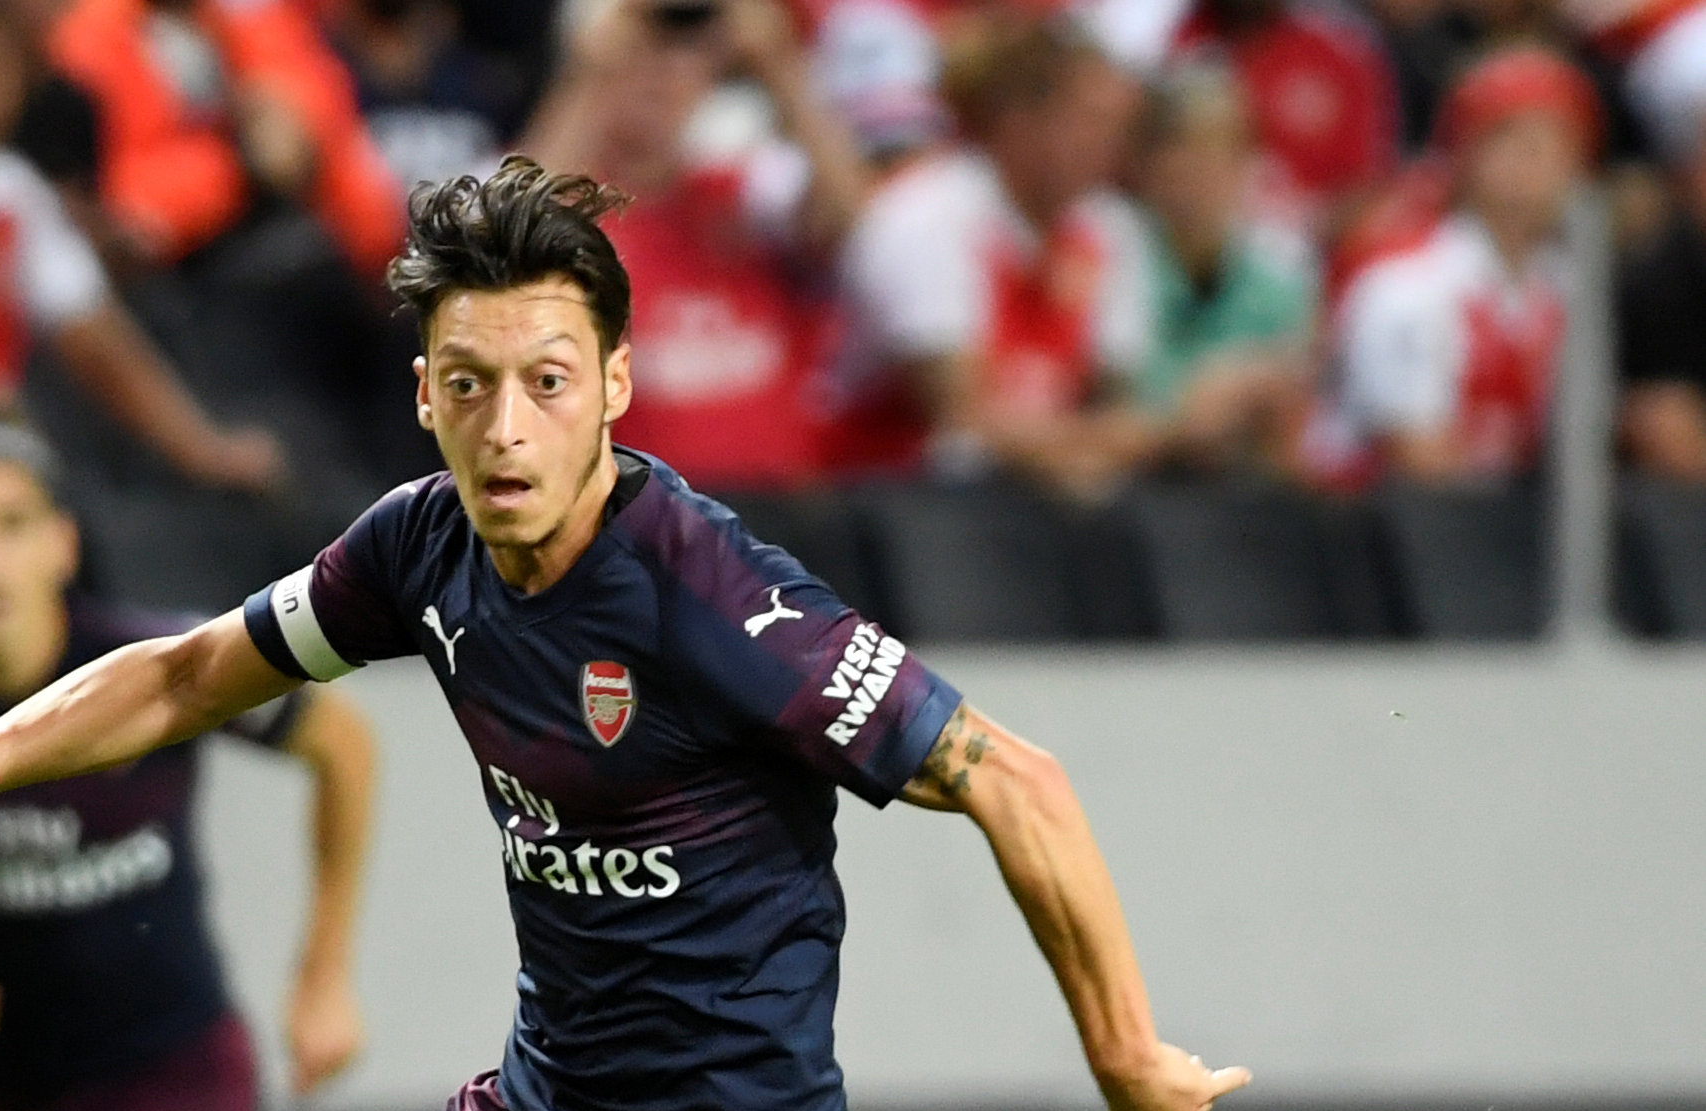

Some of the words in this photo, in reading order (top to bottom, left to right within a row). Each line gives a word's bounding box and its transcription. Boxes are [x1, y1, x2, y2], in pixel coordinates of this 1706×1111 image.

[821, 623, 880, 699] VISIT
[824, 636, 906, 746] RWAND
[488, 764, 560, 836] Fly
[504, 814, 681, 898] irates
